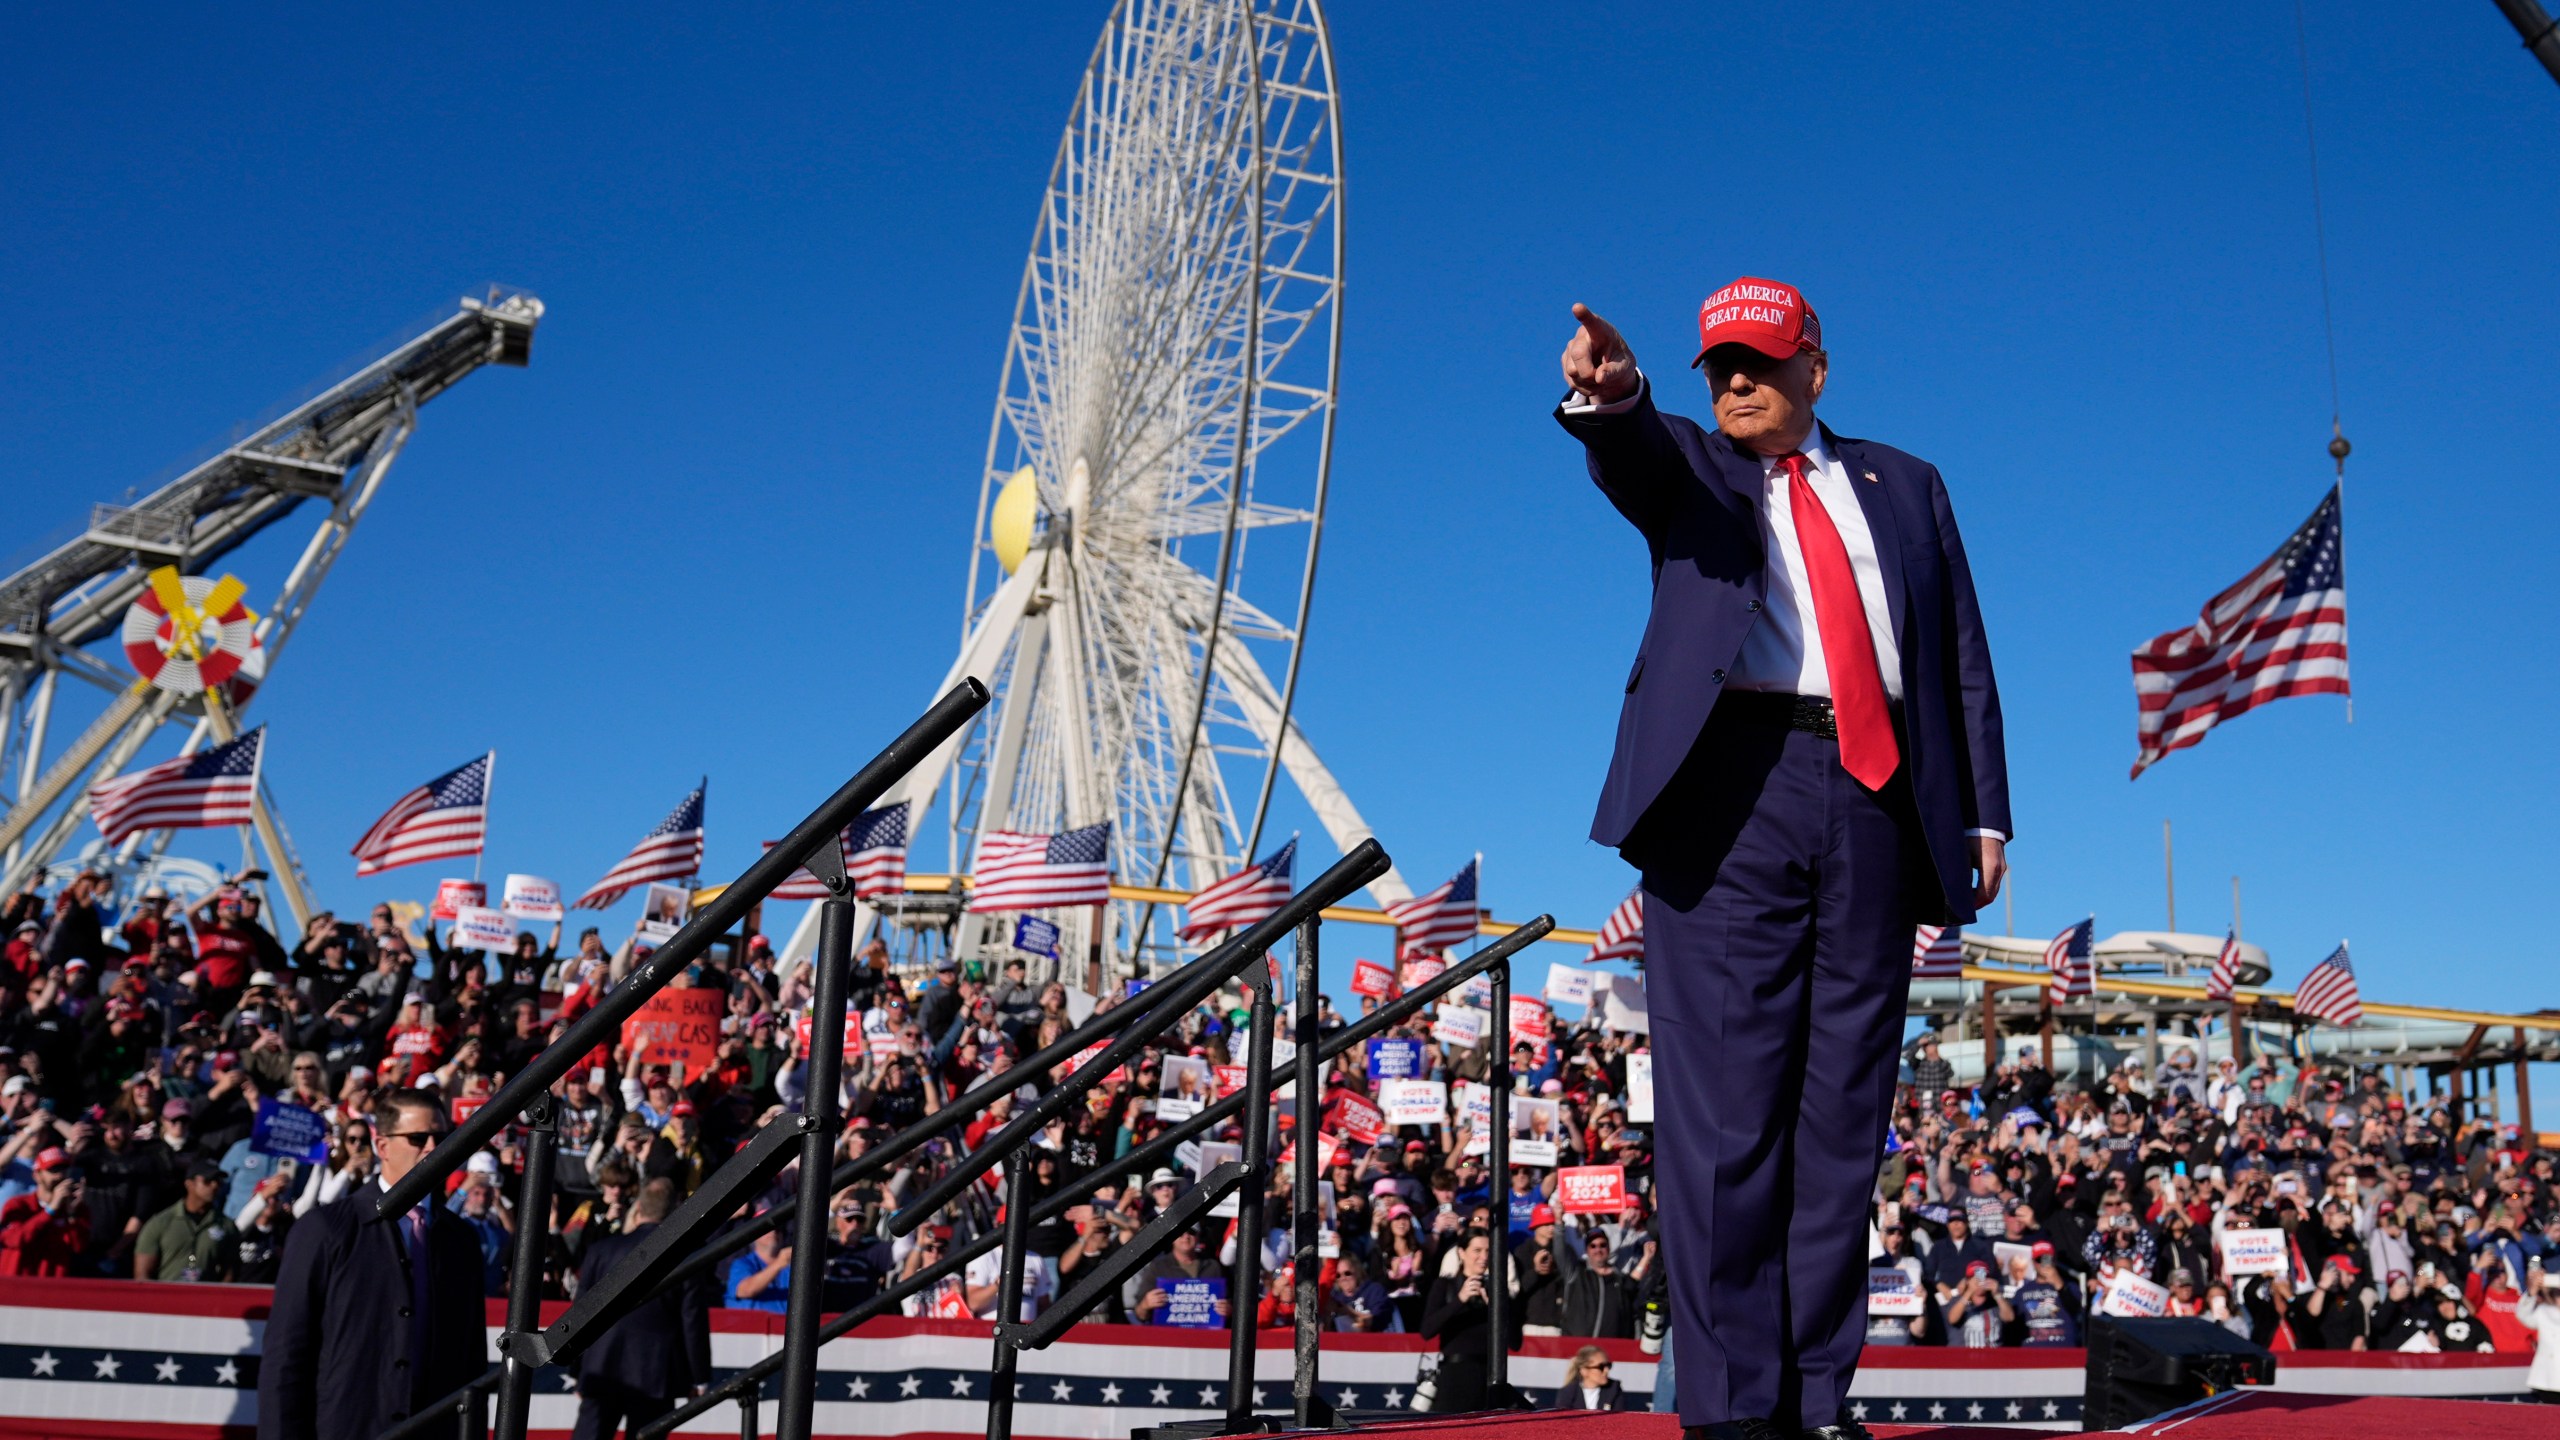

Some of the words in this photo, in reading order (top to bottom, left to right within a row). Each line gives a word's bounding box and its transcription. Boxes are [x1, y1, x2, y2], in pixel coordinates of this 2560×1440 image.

[1702, 288, 1730, 312] MAKE
[1731, 285, 1794, 308] AMERICA
[1706, 306, 1740, 331] GREAT
[1740, 306, 1785, 326] AGAIN
[521, 887, 549, 895] VOTE
[511, 895, 558, 903] DONALD
[514, 904, 552, 912] TRUMP
[474, 915, 504, 925] VOTE
[463, 922, 512, 935] DONALD
[467, 932, 506, 943] TRUMP
[684, 998, 716, 1016] BACK
[1382, 1042, 1410, 1050] MAKE
[1374, 1050, 1416, 1058] AMERICA
[1379, 1058, 1411, 1066] GREAT
[1392, 1098, 1441, 1106] DONALD
[278, 1106, 313, 1122] MAKE
[1344, 1098, 1382, 1122] TRUMP
[1398, 1106, 1438, 1114] TRUMP
[264, 1115, 322, 1136] AMERICA
[270, 1127, 310, 1144] GREAT
[1564, 1174, 1618, 1188] TRUMP
[1570, 1186, 1611, 1200] 2024
[2238, 1236, 2268, 1244] VOTE
[2230, 1246, 2280, 1256] DONALD
[2235, 1256, 2276, 1265] TRUMP
[1872, 1275, 1904, 1284] VOTE
[1174, 1284, 1210, 1294] MAKE
[2132, 1284, 2160, 1302] VOTE
[1166, 1294, 1218, 1304] AMERICA
[2117, 1289, 2160, 1313] DONALD
[1169, 1304, 1211, 1314] GREAT
[1166, 1314, 1210, 1324] AGAIN!
